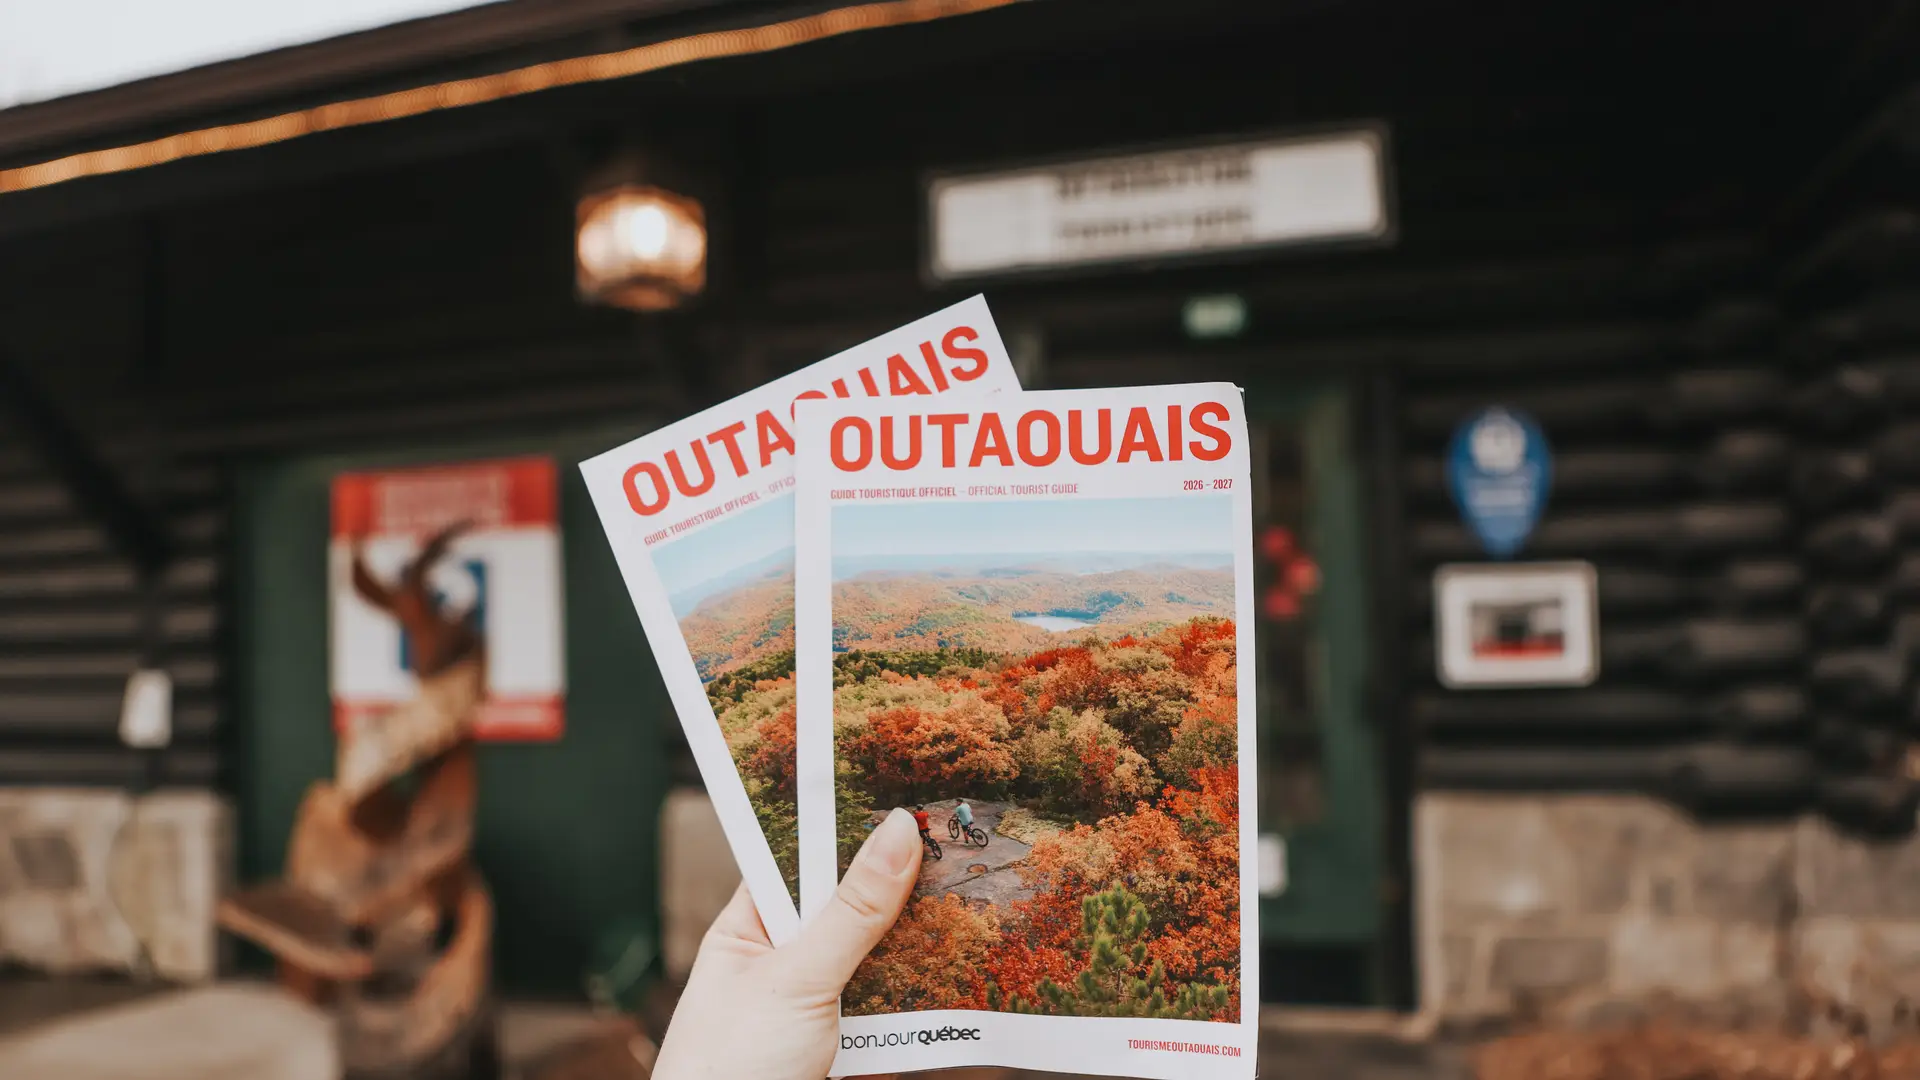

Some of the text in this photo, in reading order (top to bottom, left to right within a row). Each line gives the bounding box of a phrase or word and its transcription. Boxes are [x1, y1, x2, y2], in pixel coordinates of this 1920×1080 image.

[622, 326, 989, 516] OUTAAIS
[830, 401, 1232, 472] OUTAOUAIS
[830, 489, 857, 500] GUIDE
[859, 487, 917, 499] TOURISTIQUE
[918, 486, 957, 498] OFFICIEL
[968, 485, 1007, 496] OFFICIAL
[1010, 484, 1049, 495] TOURIST
[1051, 483, 1079, 494] GUIDE
[1183, 480, 1204, 490] 2026
[1213, 479, 1233, 489] 2027
[644, 529, 669, 546] GUIDE
[670, 506, 724, 535] TOURISTIQUE
[724, 491, 760, 512] OFFICIEL
[1127, 1039, 1241, 1057] TOURISMEOUTAOUAIS.COM
